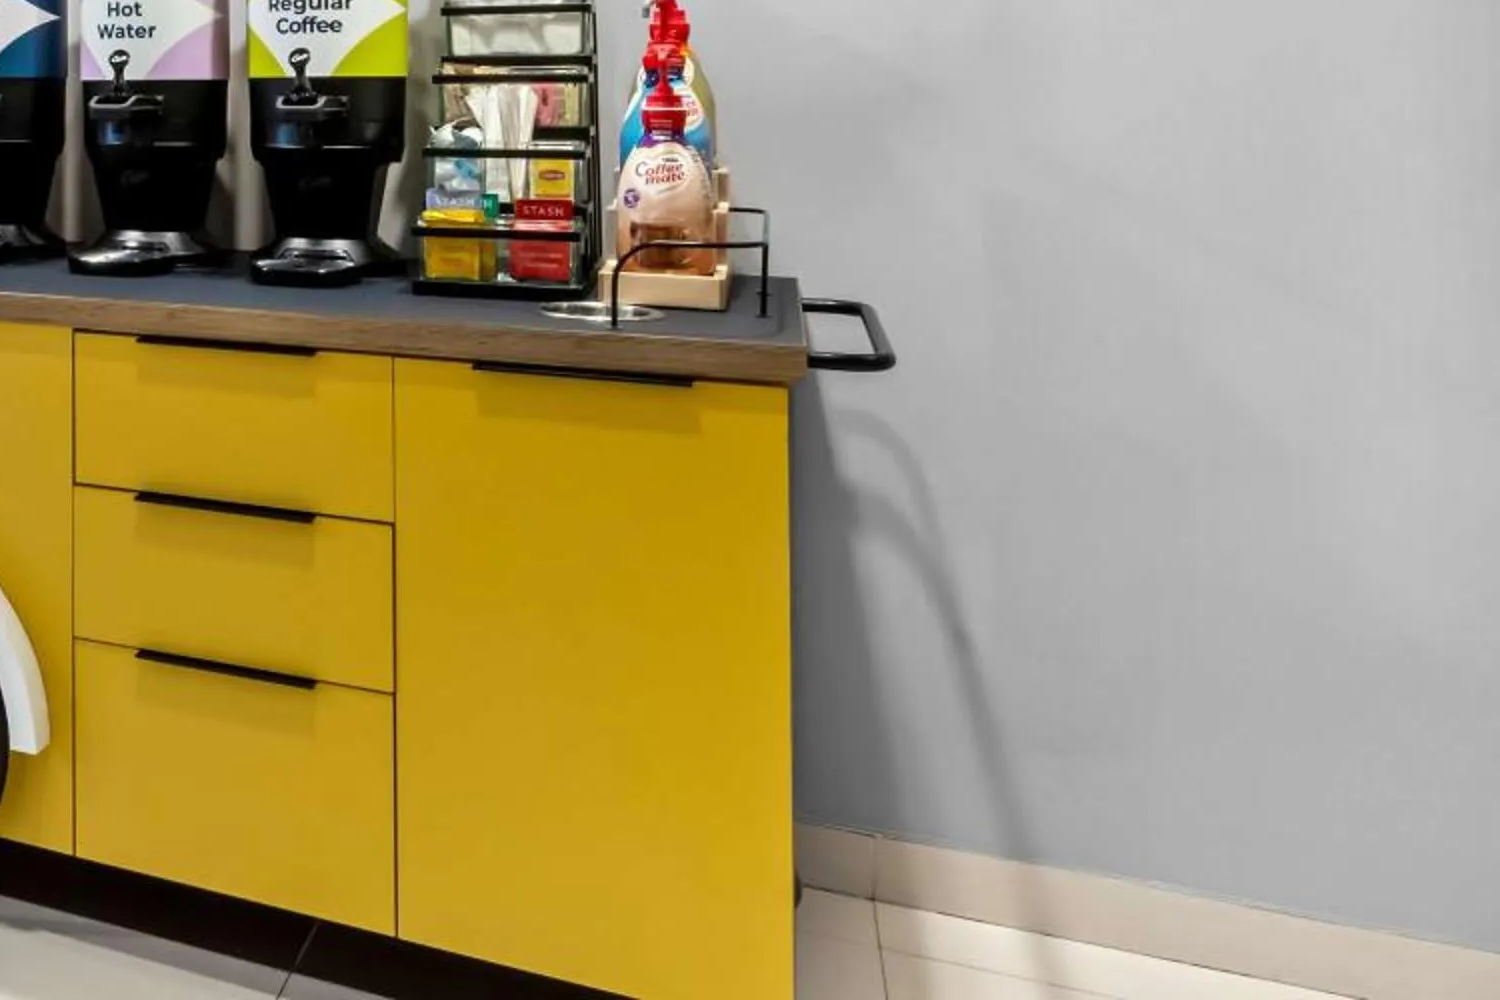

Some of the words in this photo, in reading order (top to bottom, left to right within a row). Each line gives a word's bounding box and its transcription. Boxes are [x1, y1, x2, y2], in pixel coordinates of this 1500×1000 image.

[107, 1, 143, 17] Hot
[97, 23, 156, 39] Water
[276, 15, 343, 34] Coffee
[522, 205, 565, 217] STASH
